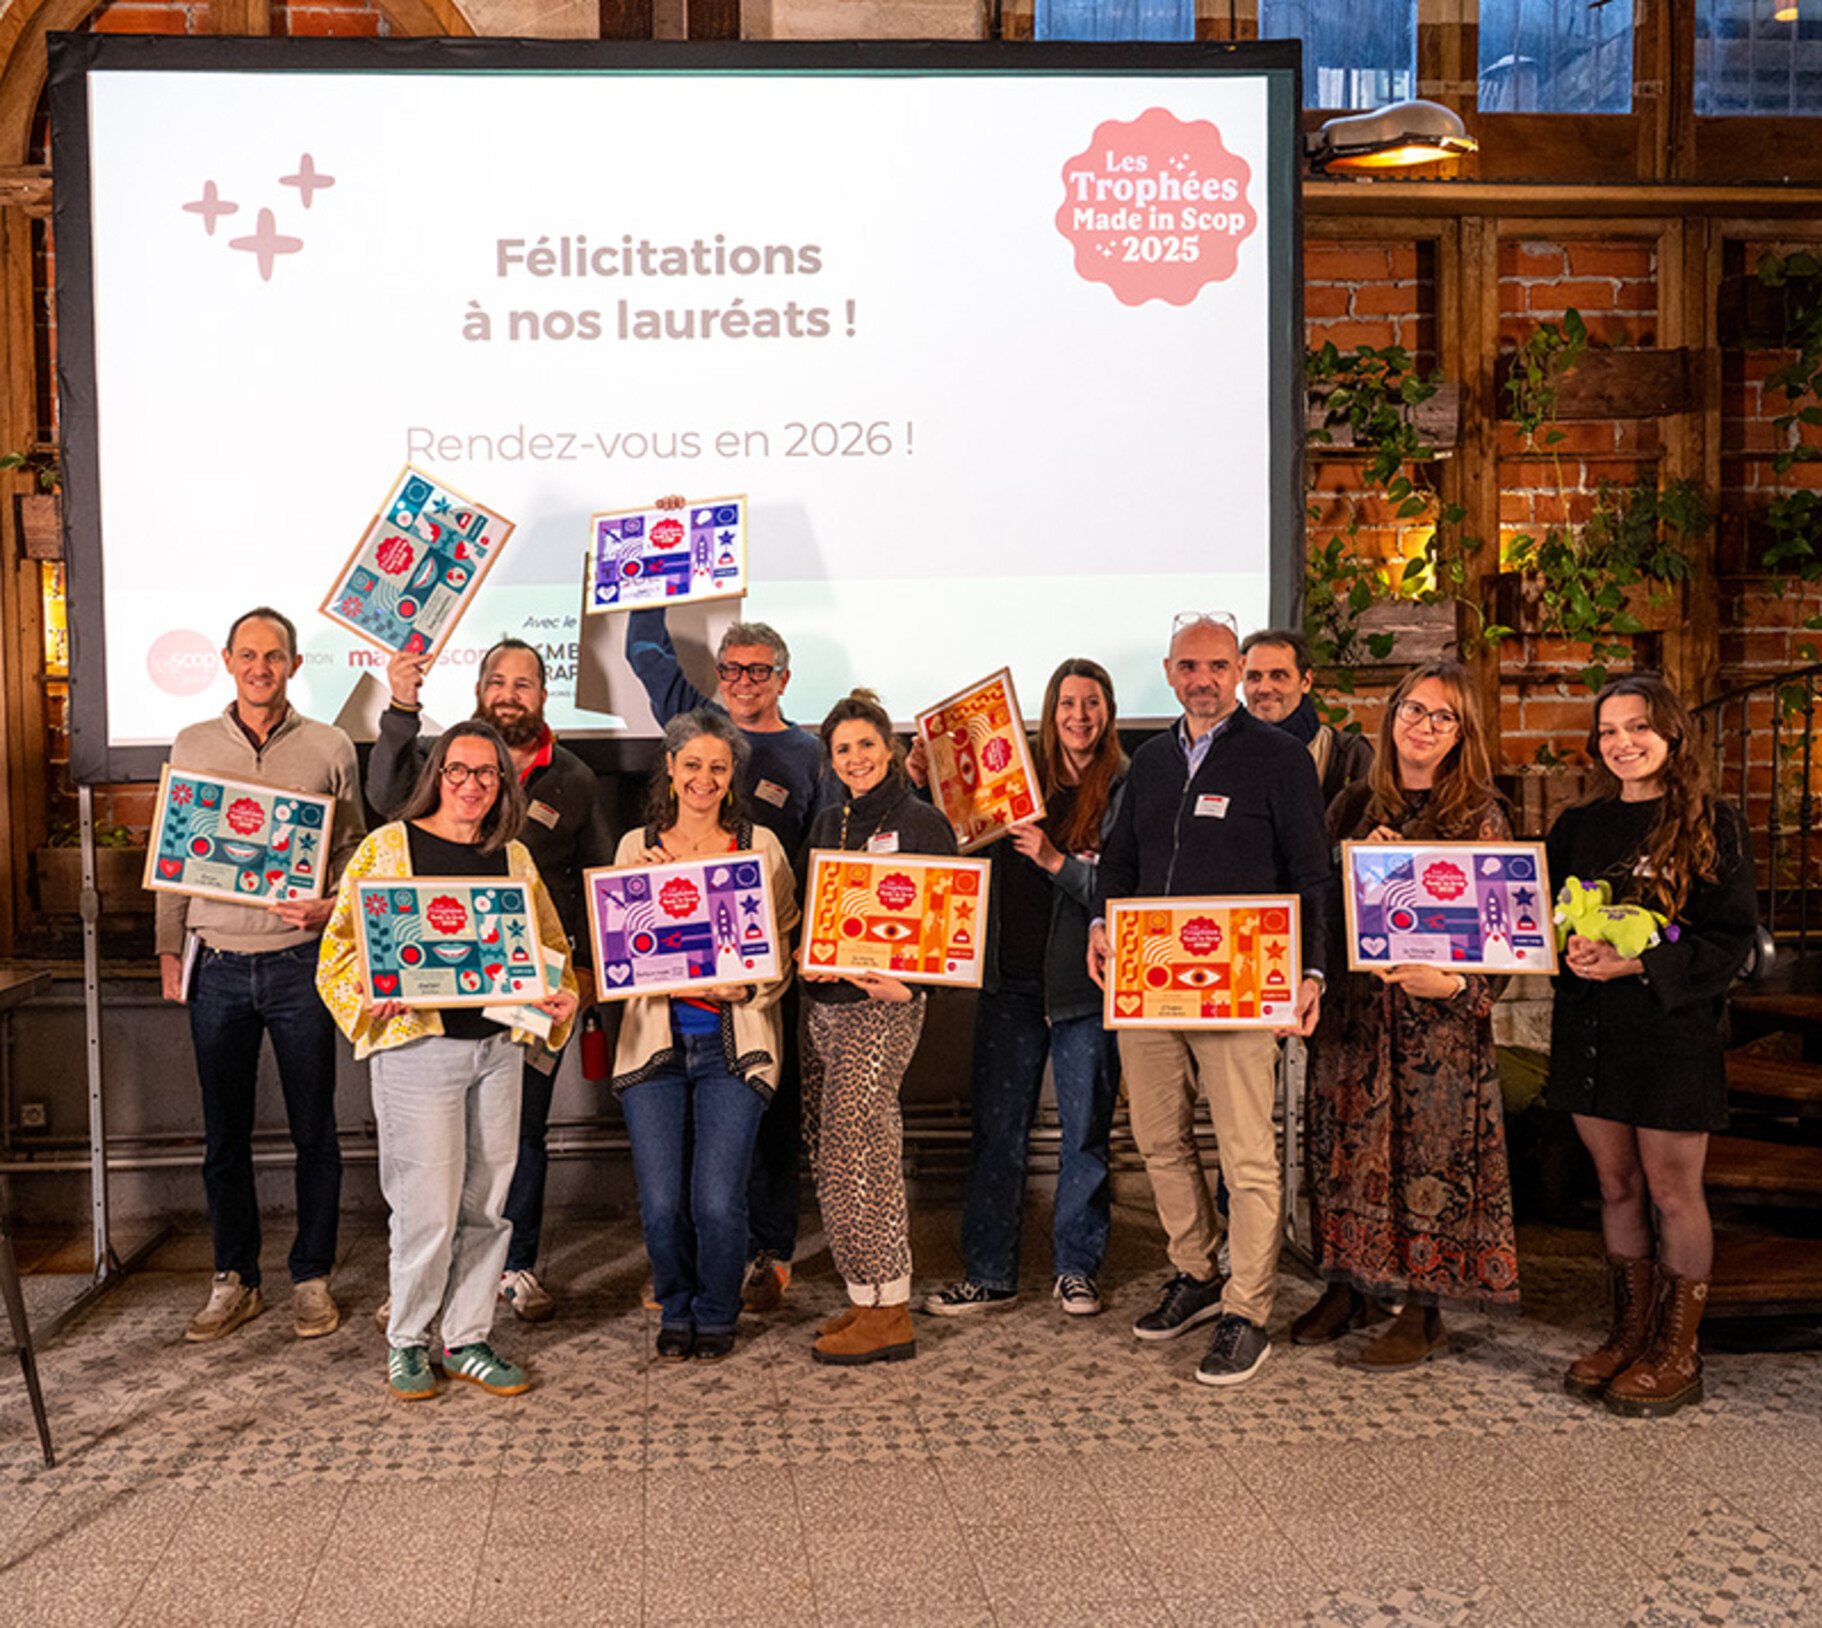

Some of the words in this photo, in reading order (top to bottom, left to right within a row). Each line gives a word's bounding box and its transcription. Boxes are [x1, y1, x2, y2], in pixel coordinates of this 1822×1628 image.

[1106, 151, 1147, 171] Les
[1070, 171, 1238, 207] Trophées
[1073, 208, 1142, 231] Made
[1149, 207, 1174, 230] in
[1181, 208, 1246, 235] Scop
[496, 234, 823, 277] Félicitations
[1122, 235, 1200, 262] 2025
[462, 300, 492, 341] à
[509, 309, 602, 341] nos
[617, 297, 831, 341] lauréats
[845, 299, 856, 338] !
[406, 424, 701, 462] Rendez-vous
[714, 431, 770, 458] en
[784, 421, 893, 457] 2026
[906, 421, 914, 456] !
[522, 616, 560, 630] Avec
[563, 615, 578, 629] le
